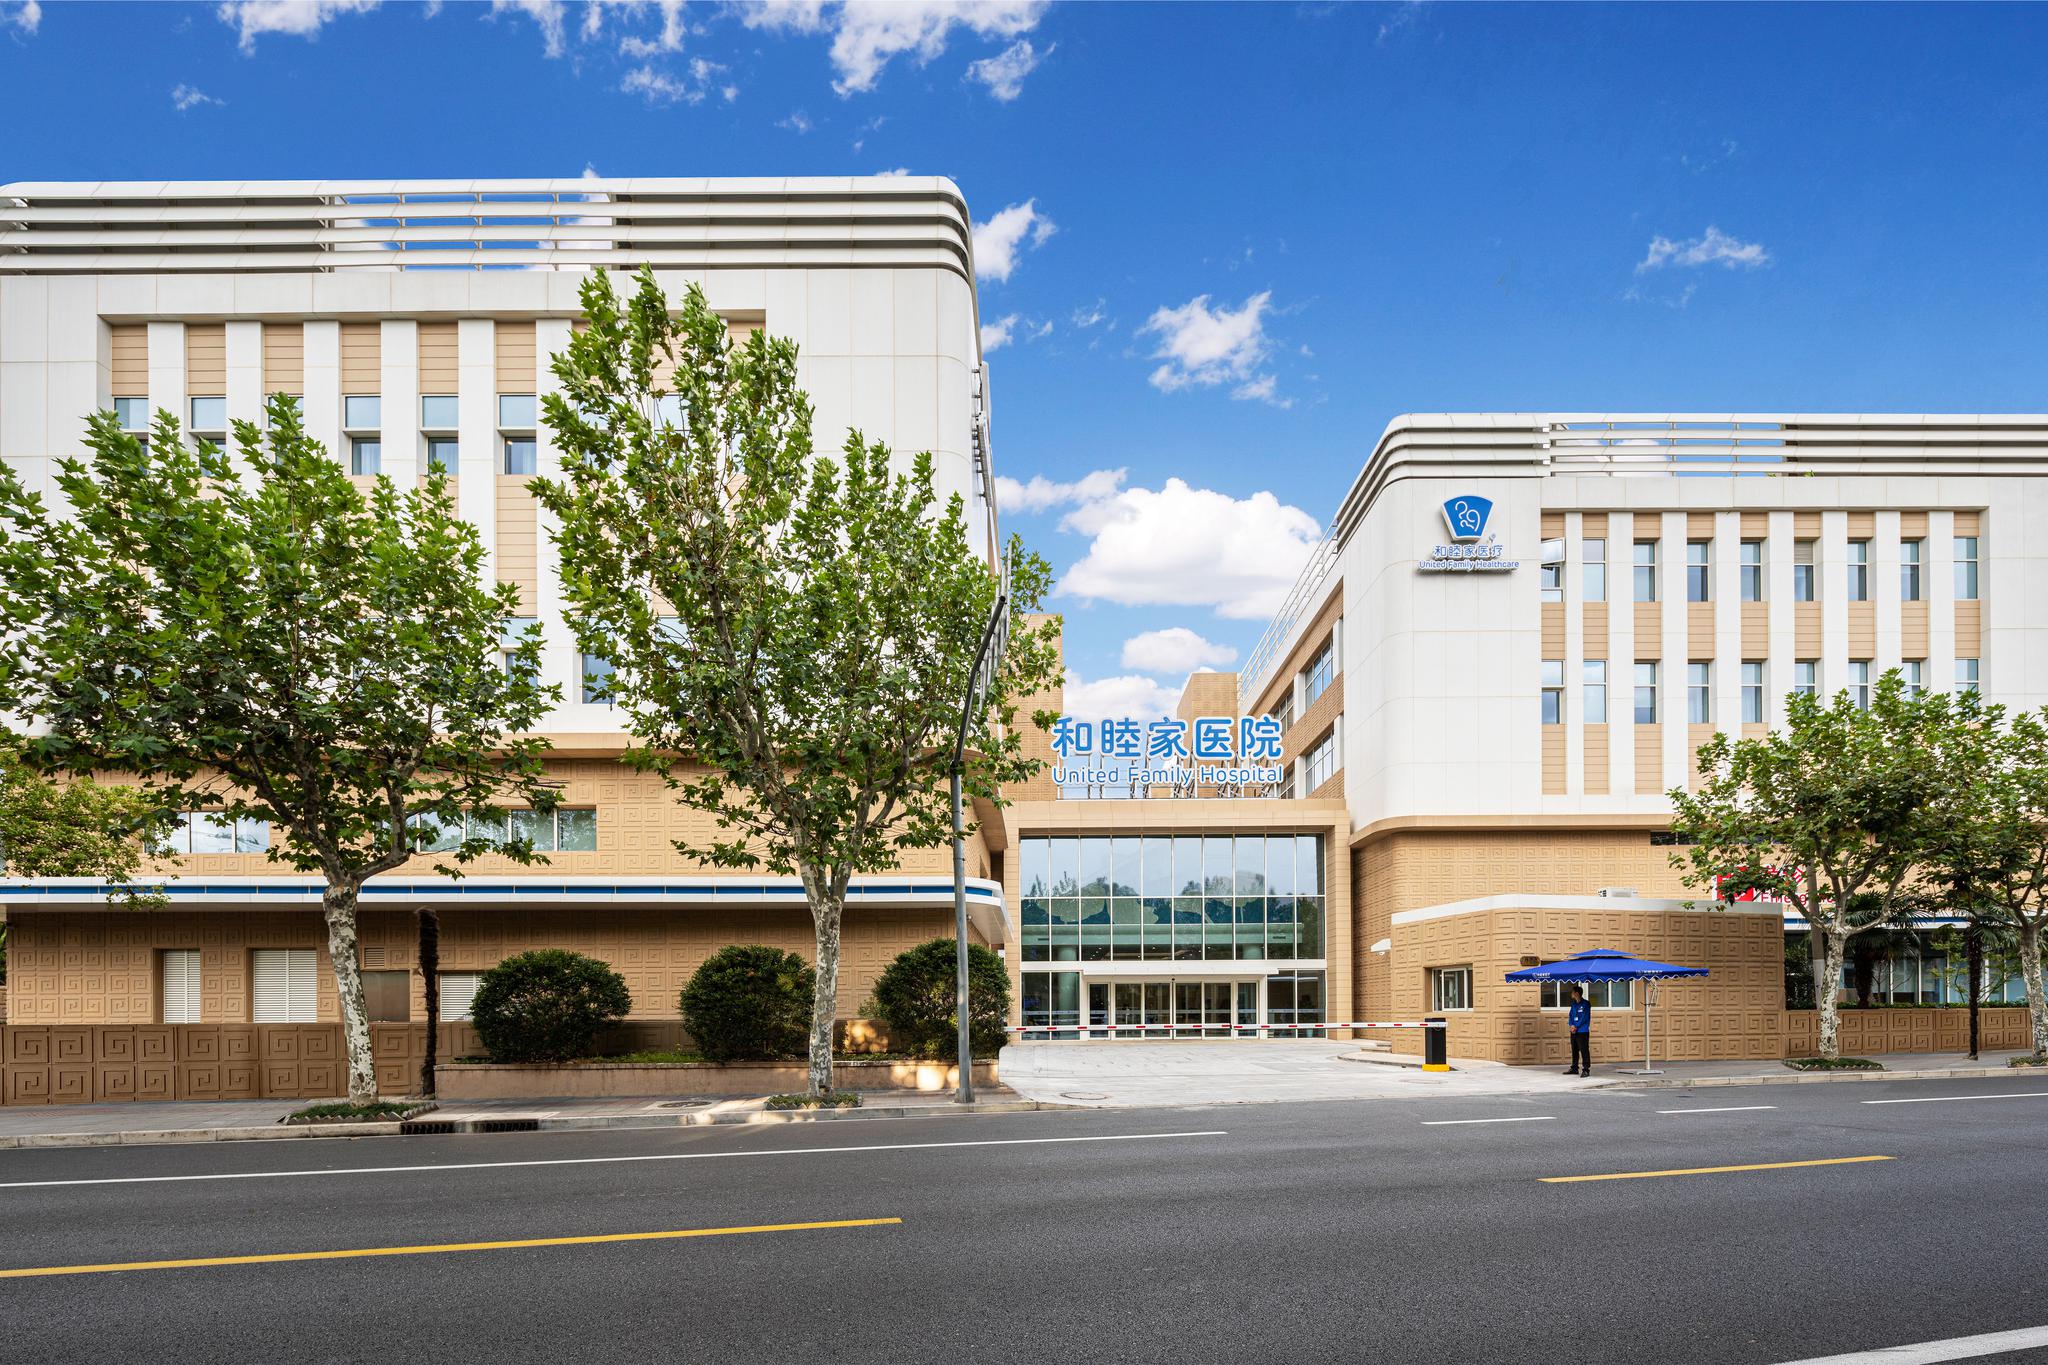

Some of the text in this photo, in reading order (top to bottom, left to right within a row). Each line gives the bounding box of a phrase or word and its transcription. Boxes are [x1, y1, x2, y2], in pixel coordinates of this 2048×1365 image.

[1434, 545, 1503, 557] 和睦家医疗
[1419, 560, 1519, 570] United Family Healthcare
[1053, 716, 1283, 758] 和睦家医院
[1053, 767, 1283, 786] United Family Hospital
